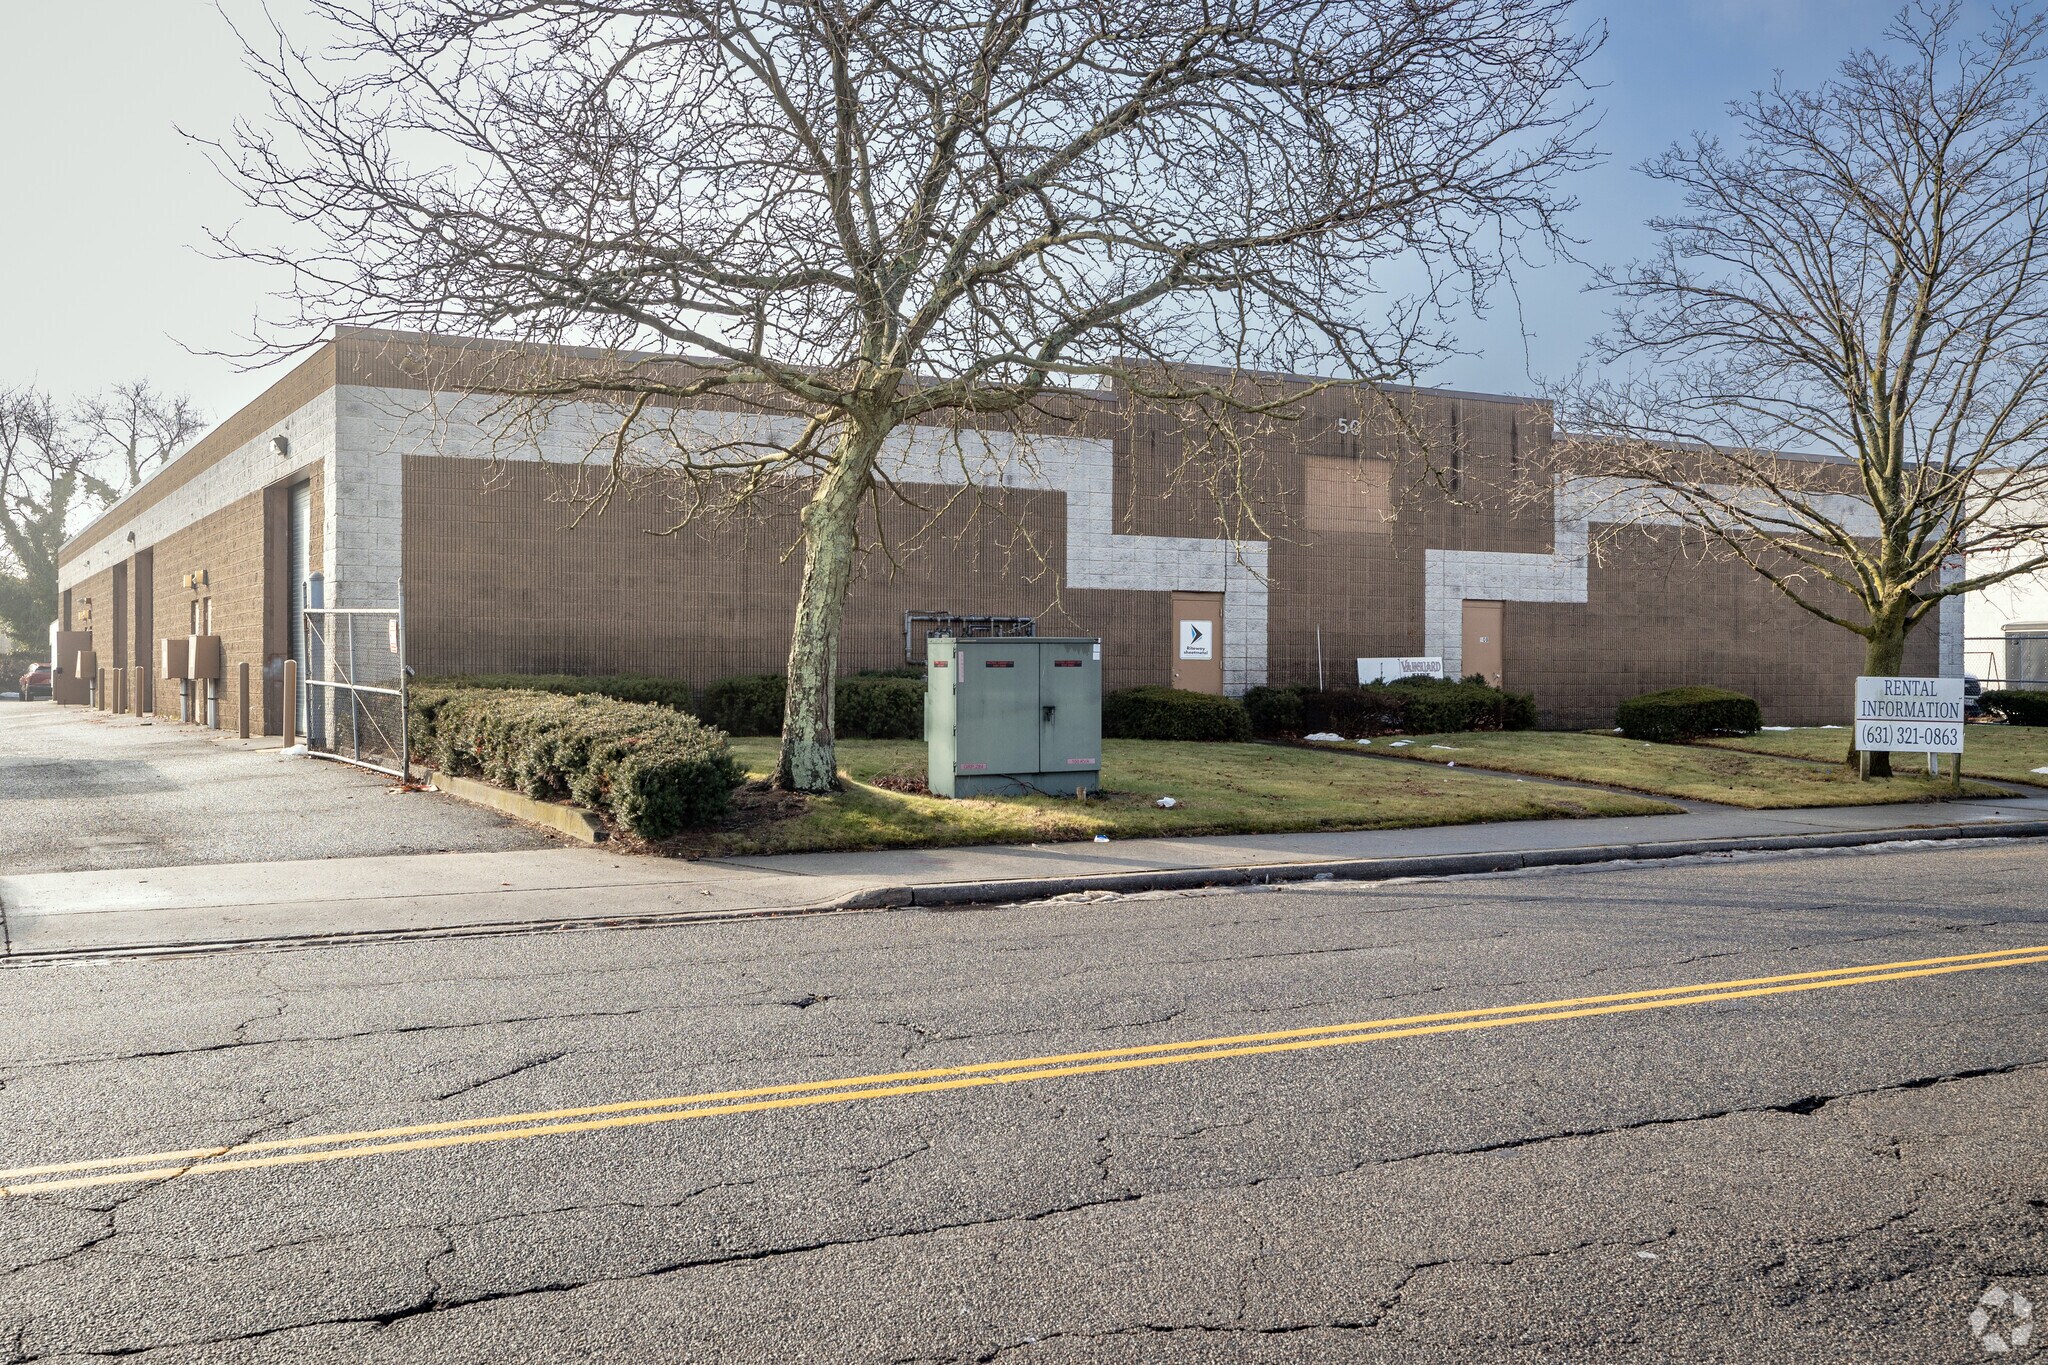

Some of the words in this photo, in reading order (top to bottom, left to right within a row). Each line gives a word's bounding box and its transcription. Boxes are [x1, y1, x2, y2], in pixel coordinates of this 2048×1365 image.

[1338, 418, 1361, 436] 50
[1400, 659, 1441, 673] VANGUARD
[1884, 679, 1938, 697] RENTAL
[1861, 700, 1960, 719] INFORMATION
[1862, 724, 1894, 746] (631)
[1896, 727, 1958, 746] 321-0863
